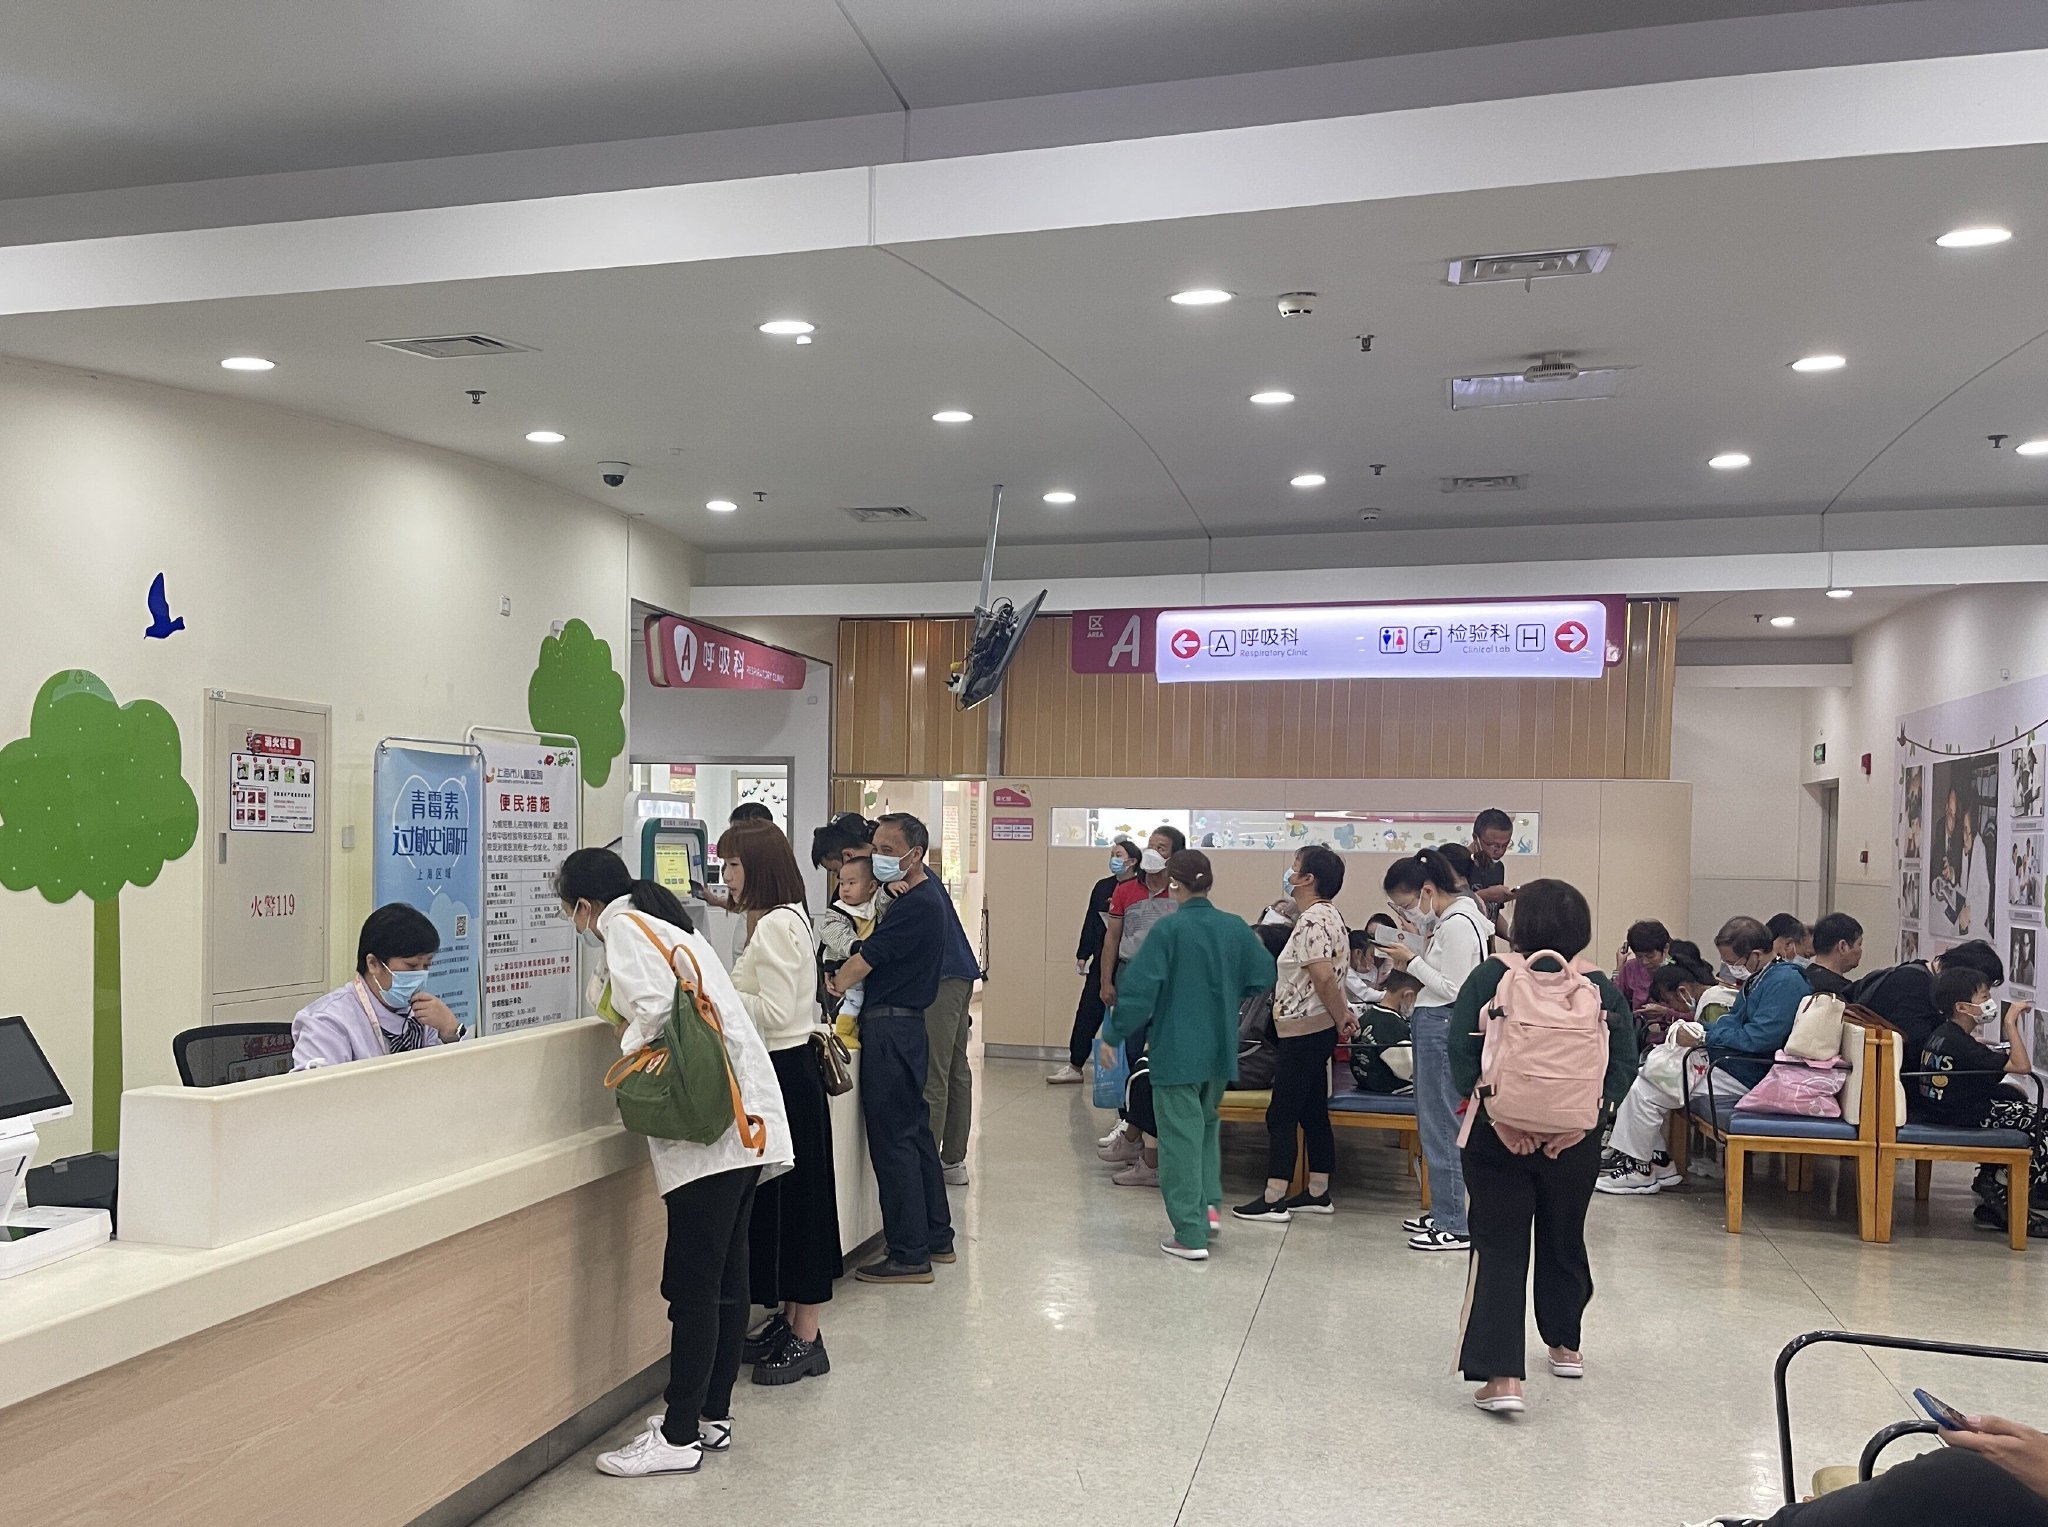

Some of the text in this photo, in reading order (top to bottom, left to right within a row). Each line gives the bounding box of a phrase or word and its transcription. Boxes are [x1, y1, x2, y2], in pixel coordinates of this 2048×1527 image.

[1107, 614, 1141, 668] A
[1214, 634, 1230, 652] A
[1240, 627, 1299, 647] 呼吸科
[1448, 624, 1511, 643] 检验科
[1523, 629, 1538, 647] H
[681, 633, 691, 671] A
[1240, 649, 1309, 658] Respiratory Clinic
[1463, 646, 1494, 654] Clinical
[703, 641, 745, 679] 呼吸科
[411, 789, 459, 820] 青霉素
[500, 794, 551, 813] 便民措施
[392, 826, 468, 855] 过敏史调研
[417, 867, 452, 881] 上海区域
[251, 894, 296, 918] 火警119
